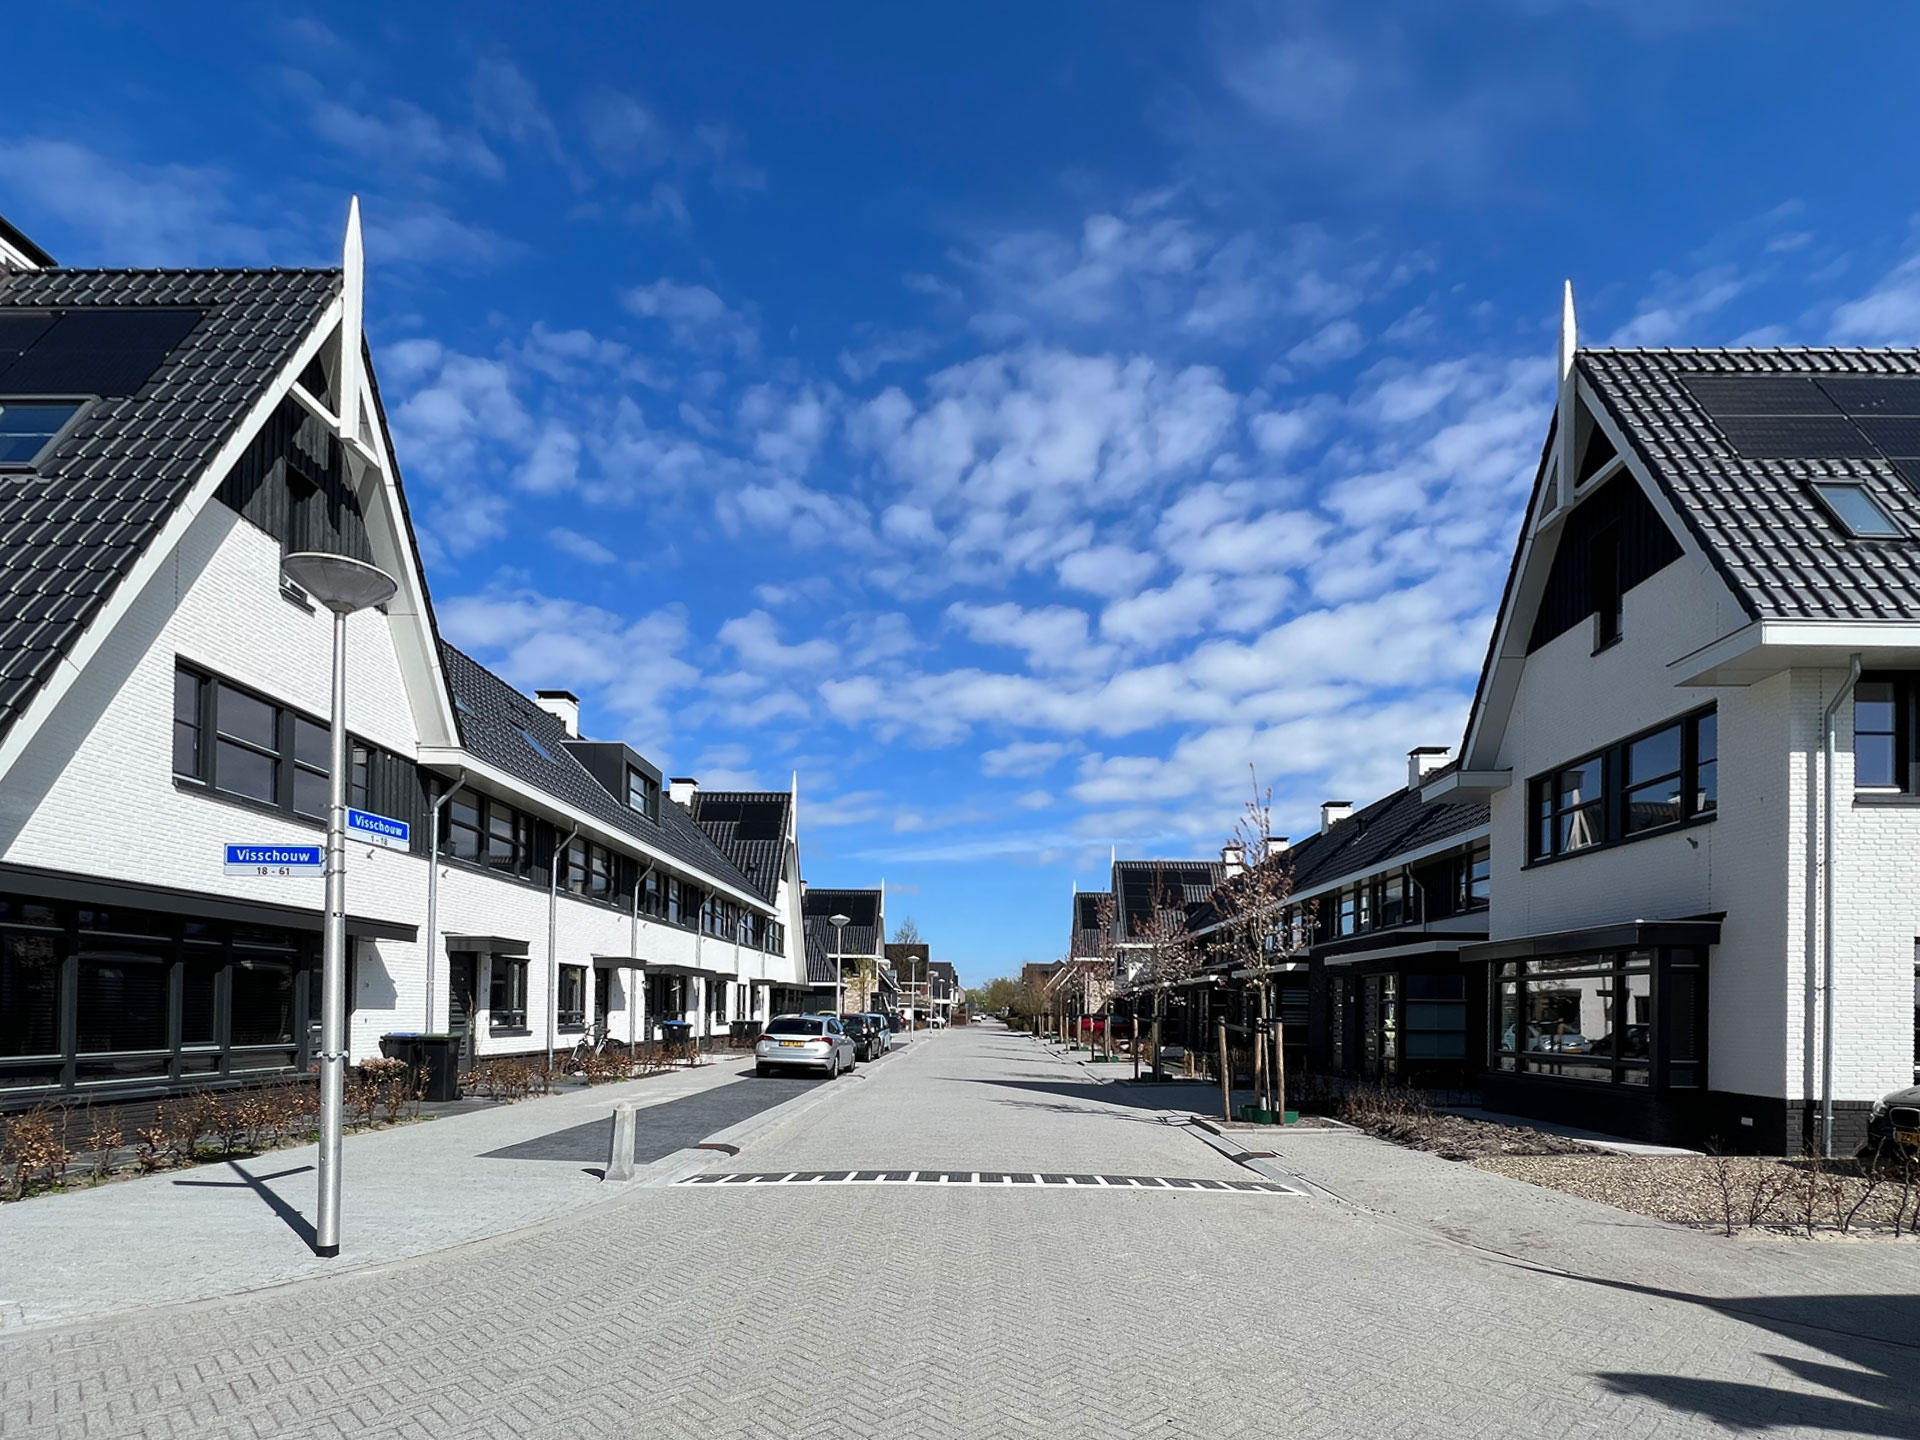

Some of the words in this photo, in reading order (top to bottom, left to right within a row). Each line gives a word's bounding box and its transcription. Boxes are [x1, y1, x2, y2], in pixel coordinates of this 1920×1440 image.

[354, 814, 403, 836] Visschouw
[236, 849, 310, 862] Visschouw
[257, 867, 268, 876] 18
[279, 867, 290, 876] 61
